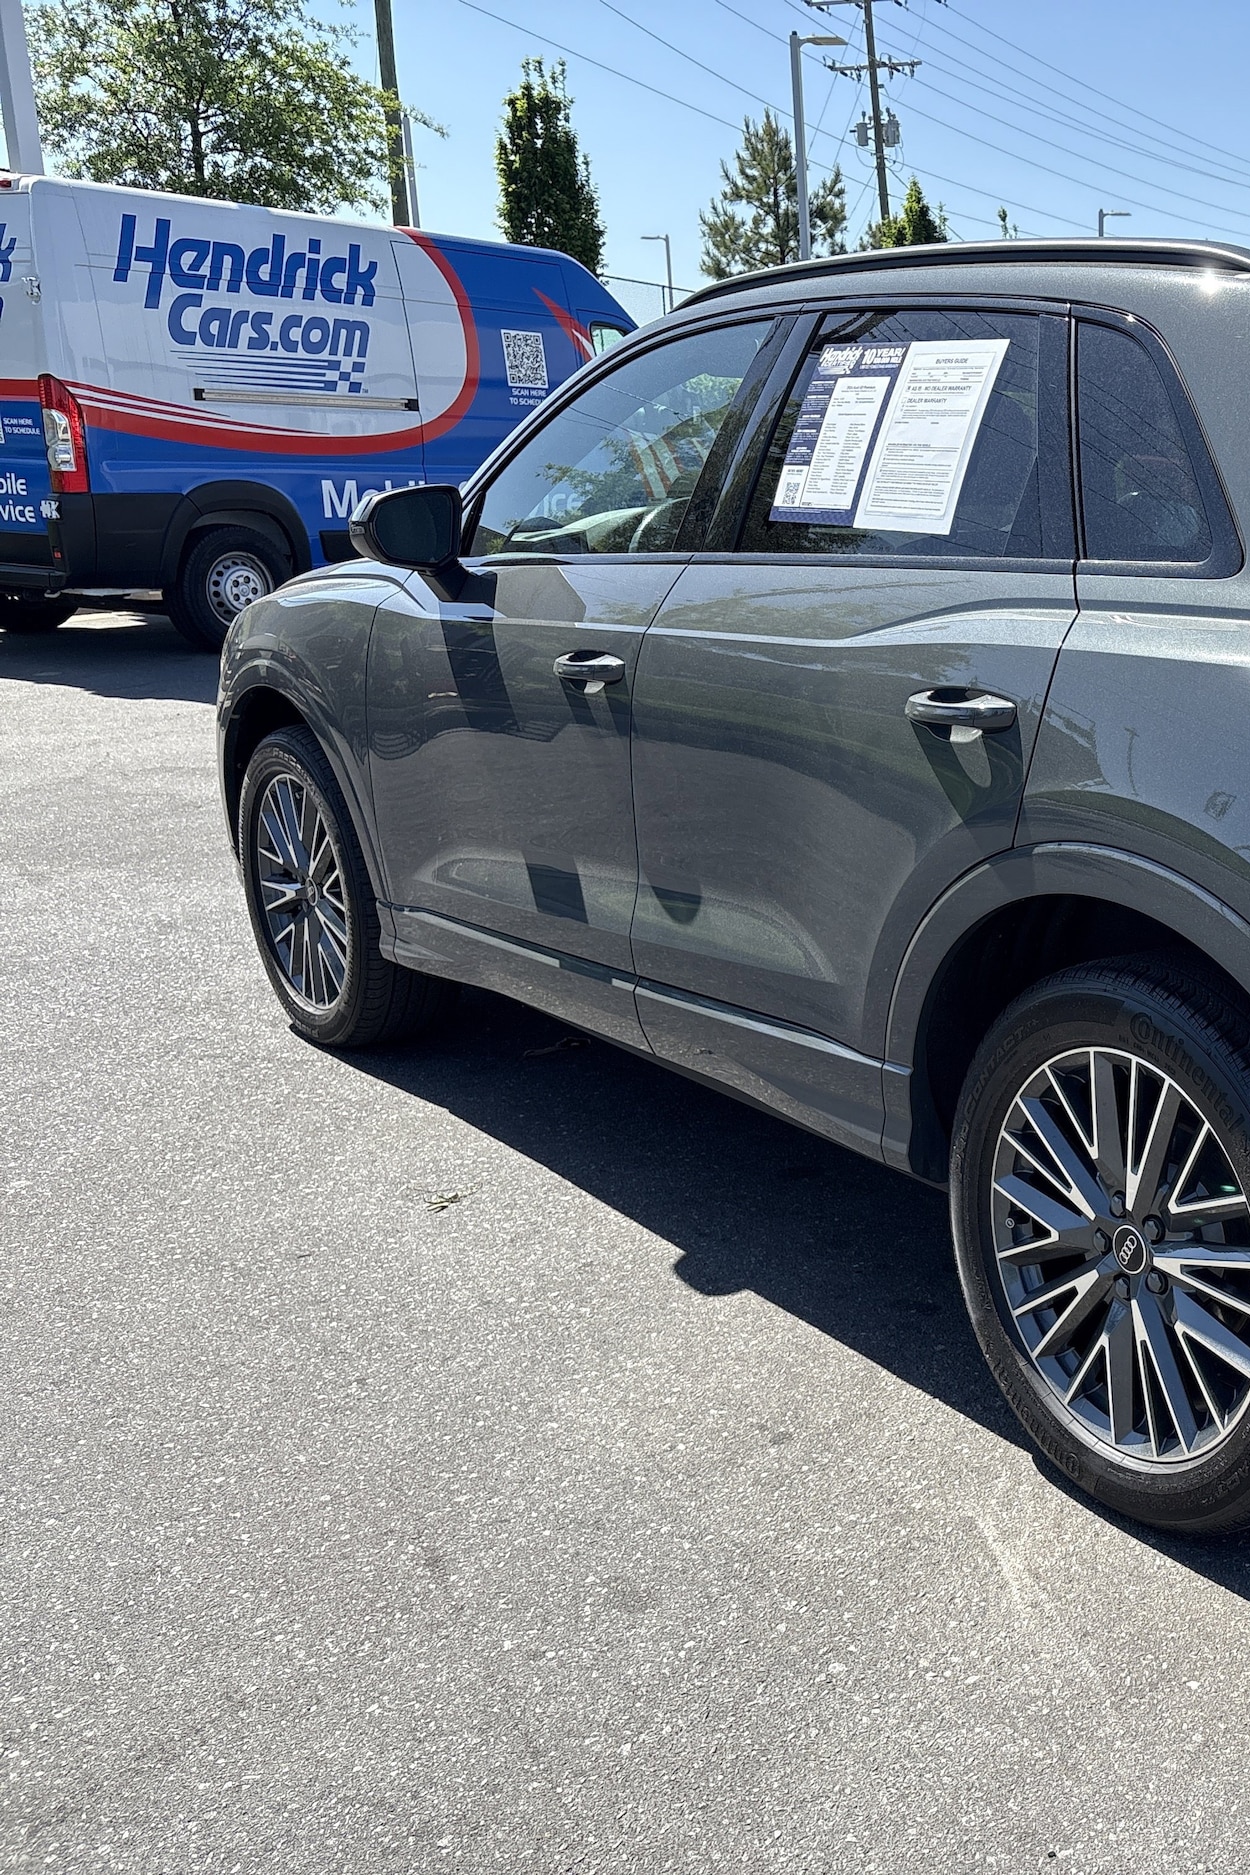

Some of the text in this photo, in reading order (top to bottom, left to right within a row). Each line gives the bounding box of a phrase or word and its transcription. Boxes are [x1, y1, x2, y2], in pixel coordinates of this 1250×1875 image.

[113, 213, 378, 309] Hendrick
[168, 292, 370, 358] Cars.com
[862, 348, 876, 364] 10
[512, 388, 546, 397] SCAN HERE
[509, 397, 518, 405] TO
[3, 417, 33, 426] SCAN HERE
[5, 426, 40, 435] TO SCHEDULE
[1129, 1010, 1247, 1138] Continental
